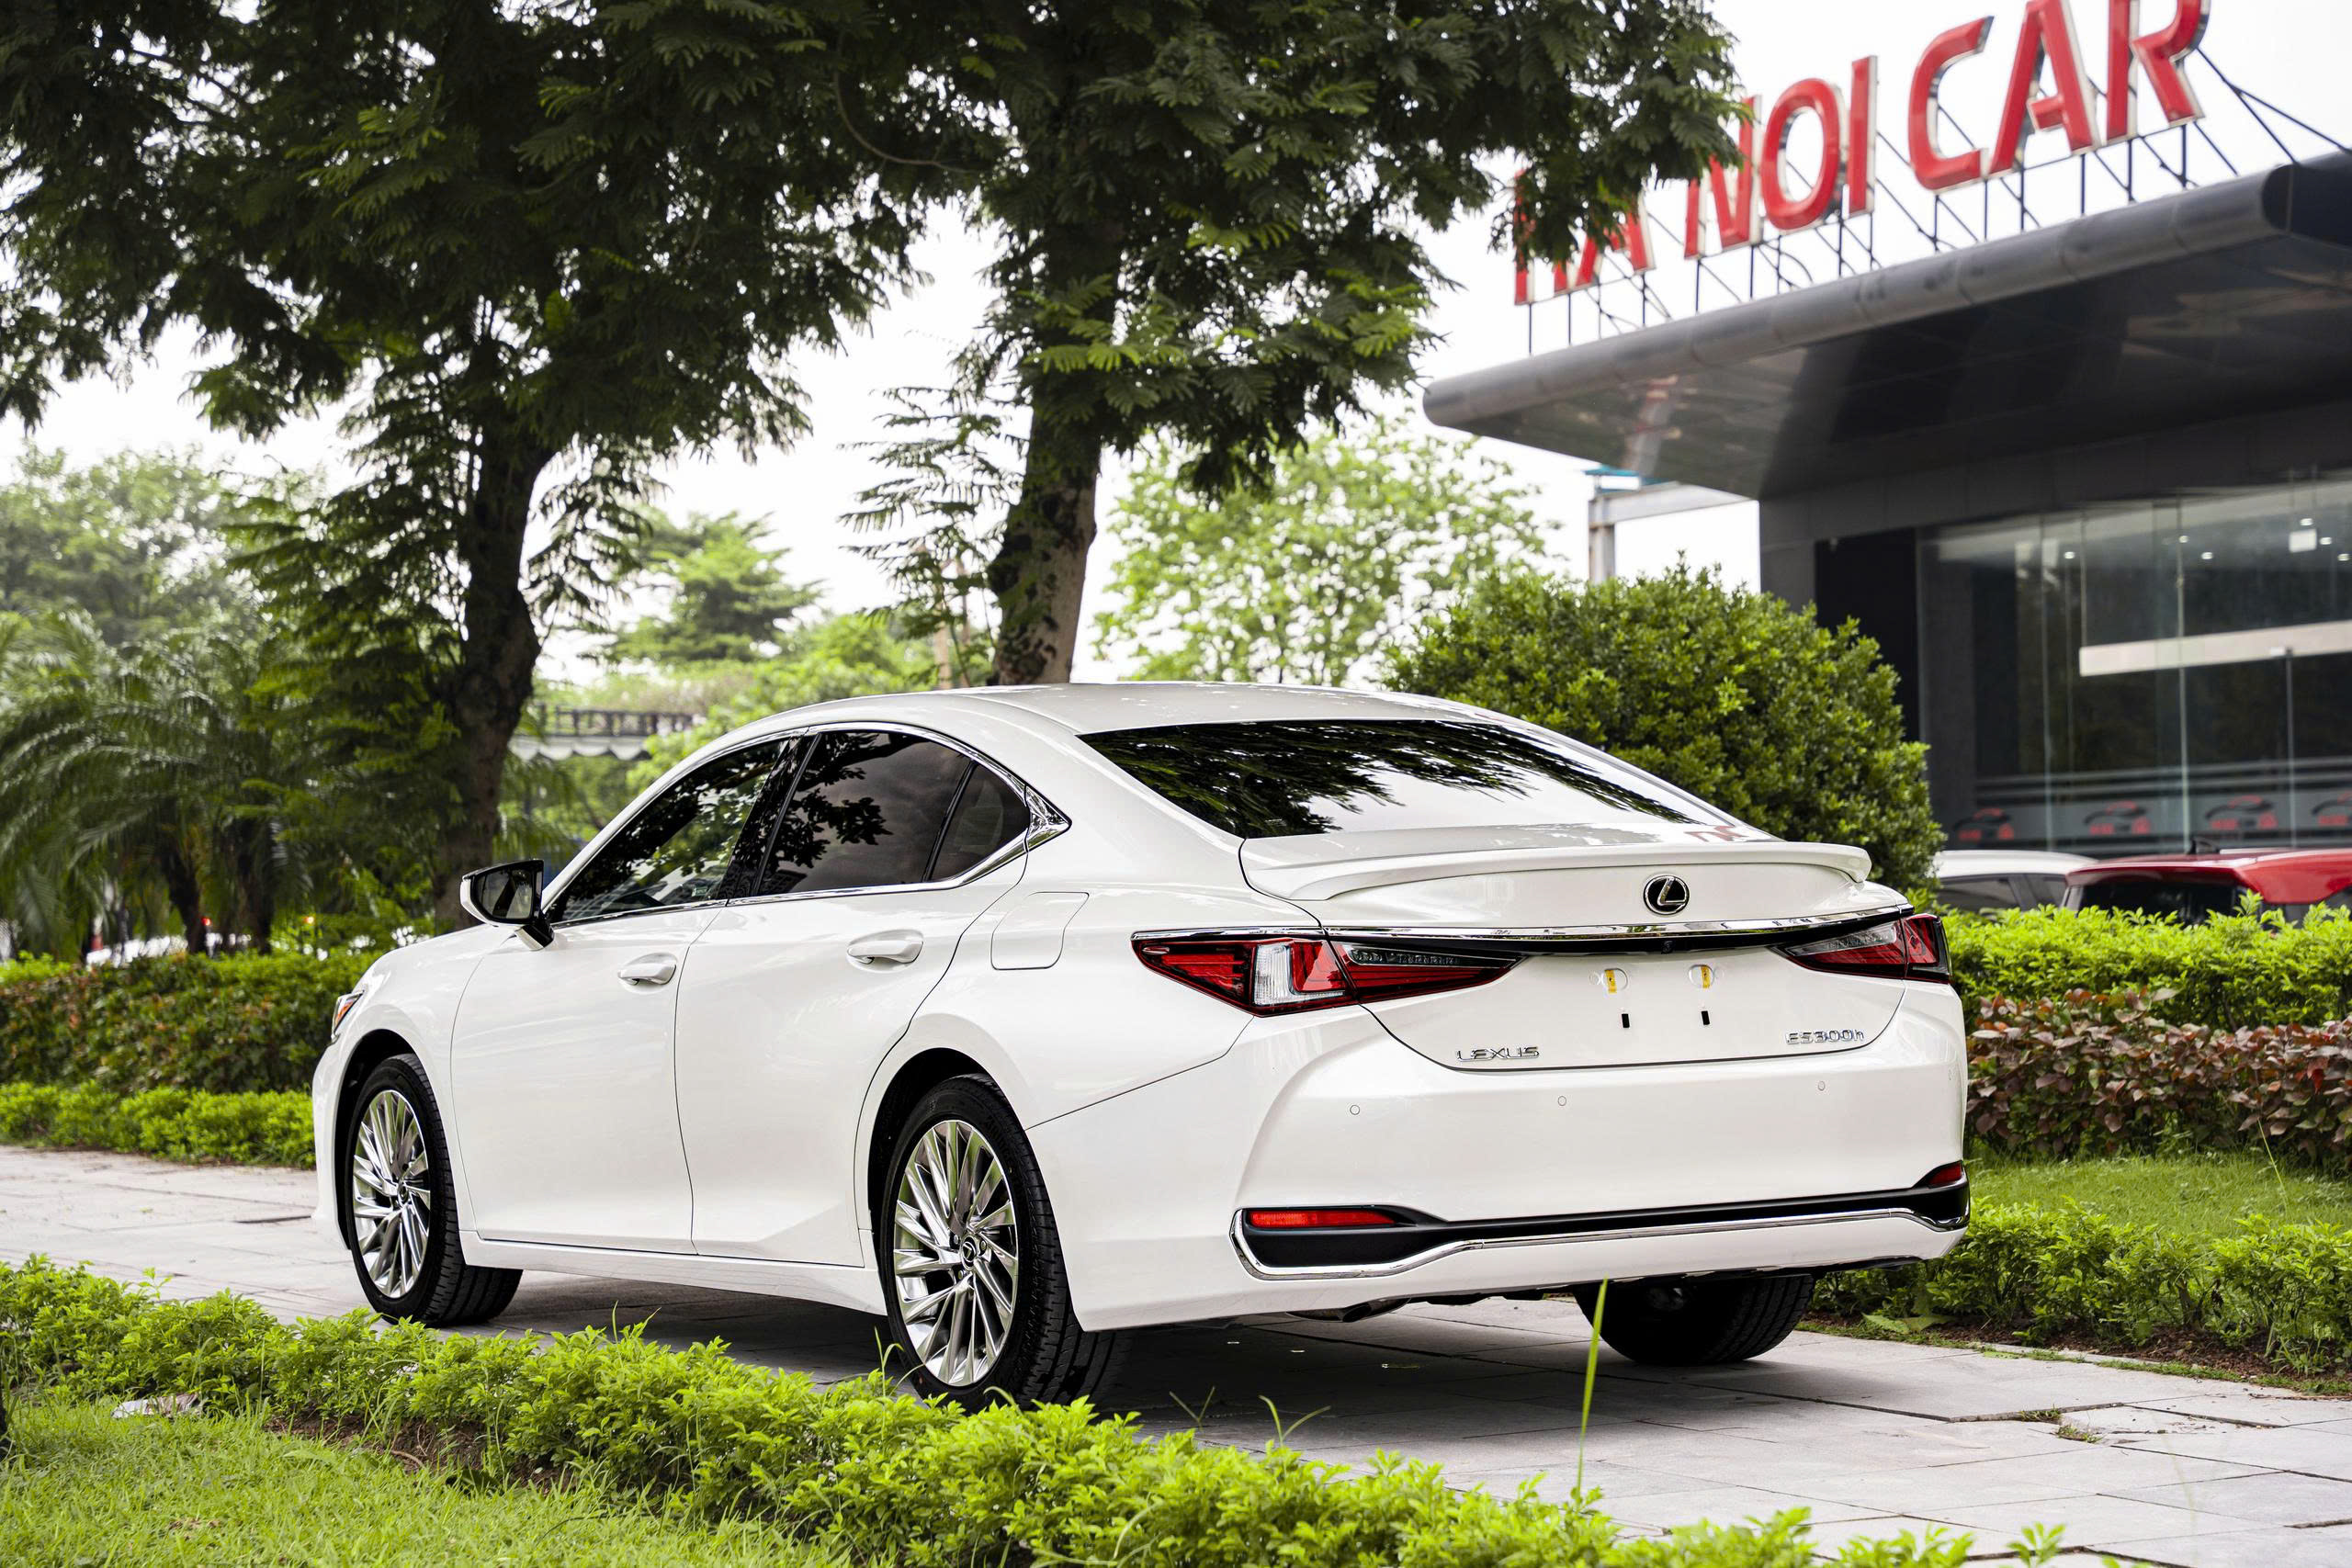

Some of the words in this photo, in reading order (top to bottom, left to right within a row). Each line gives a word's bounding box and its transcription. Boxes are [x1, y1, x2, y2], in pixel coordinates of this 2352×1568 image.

[1683, 55, 1878, 261] NOI
[1907, 0, 2209, 195] CAR
[1785, 1028, 1866, 1045] ES300h
[1456, 1045, 1540, 1063] LEXUS
